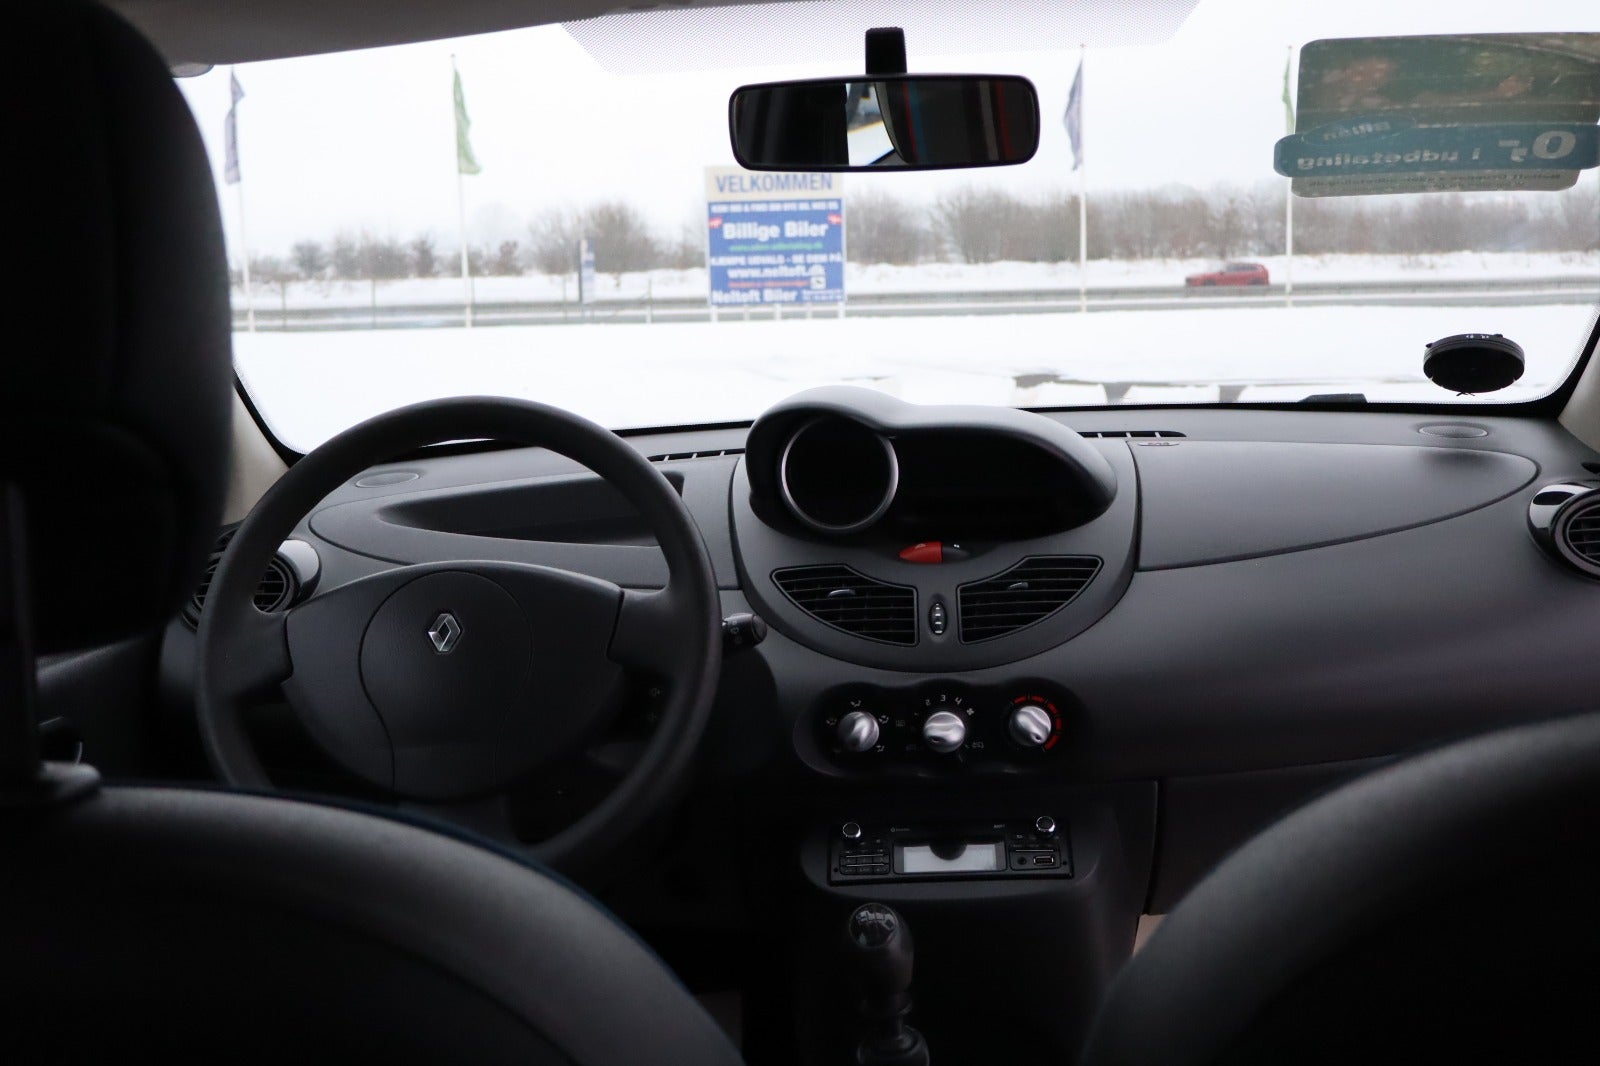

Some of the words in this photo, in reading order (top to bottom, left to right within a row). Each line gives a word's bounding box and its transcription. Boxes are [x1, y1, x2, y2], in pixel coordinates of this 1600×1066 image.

[716, 174, 832, 193] VELKOMMEN
[723, 222, 780, 241] Billige
[784, 221, 829, 238] Biler
[940, 694, 946, 702] 3
[955, 697, 962, 705] 4
